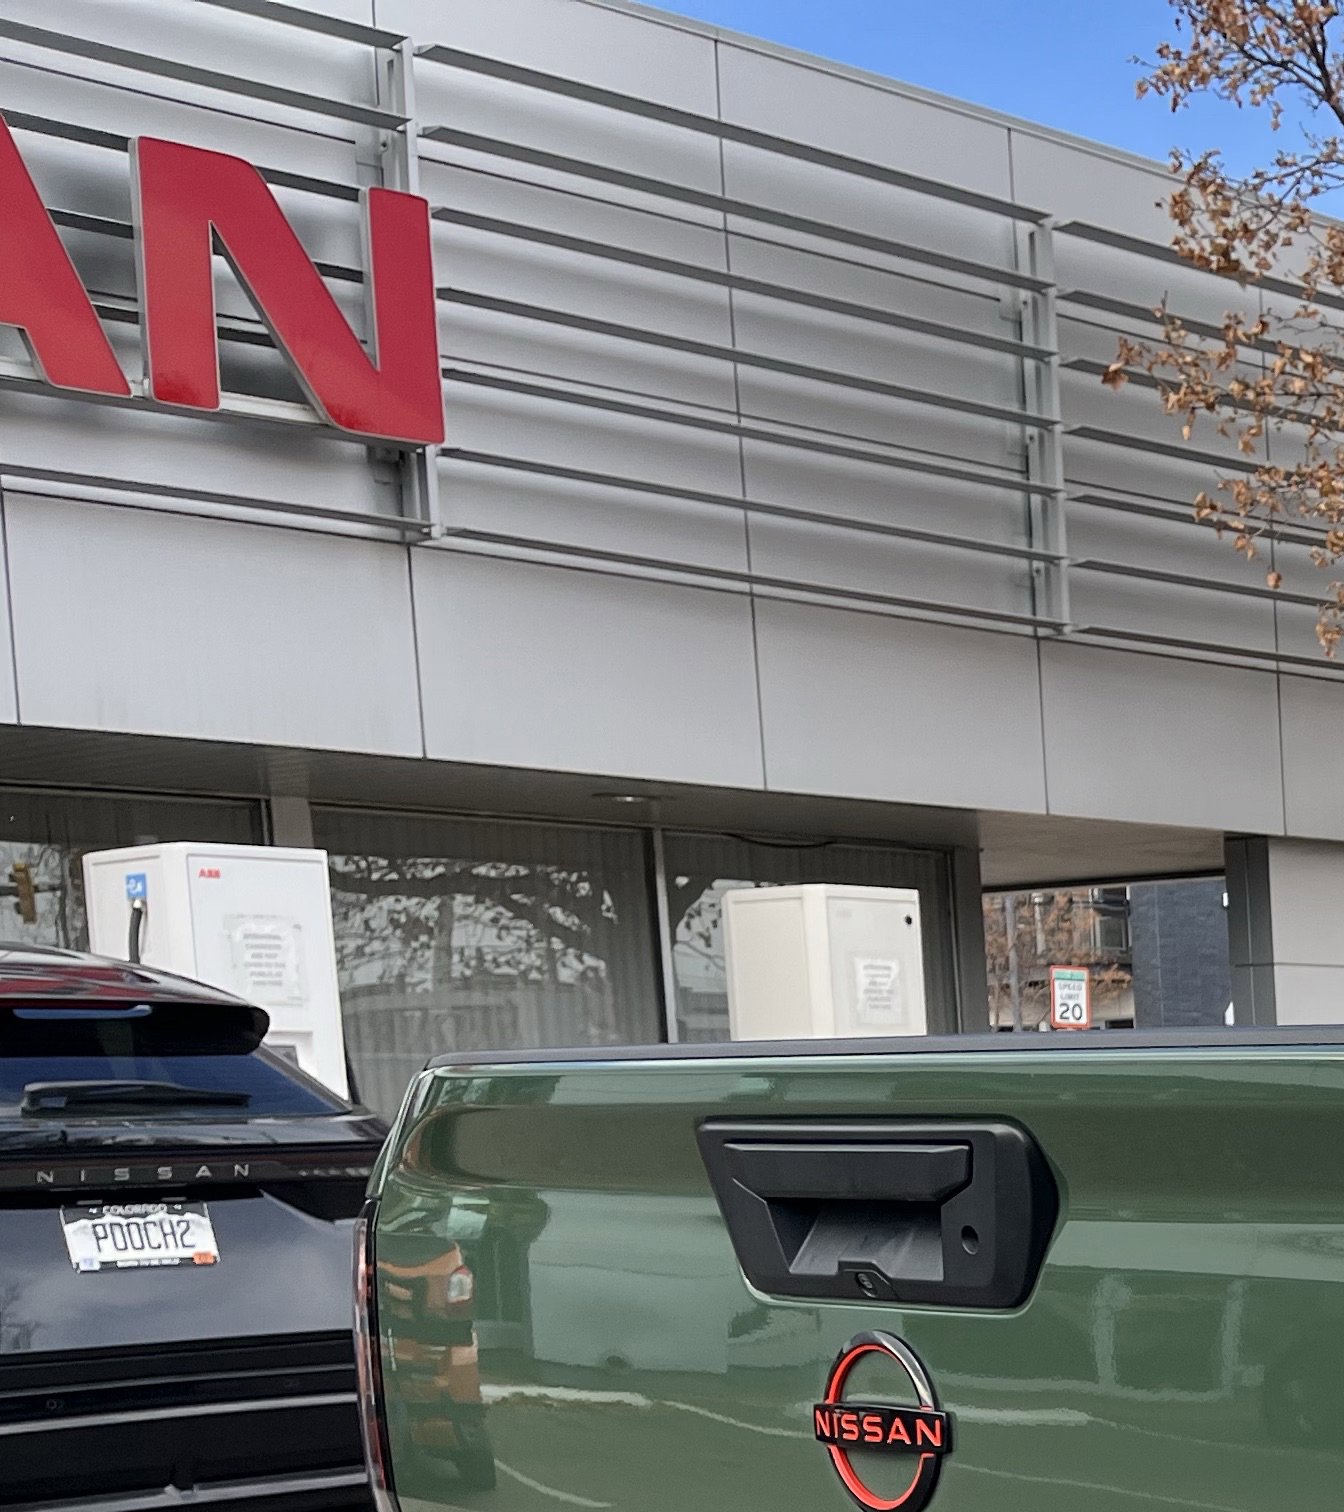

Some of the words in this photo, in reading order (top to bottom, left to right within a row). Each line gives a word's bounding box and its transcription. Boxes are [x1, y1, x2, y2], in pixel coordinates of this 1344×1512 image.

[1059, 1003, 1083, 1021] 20
[36, 1164, 249, 1184] NISSAN
[815, 1409, 942, 1447] NISSAN
